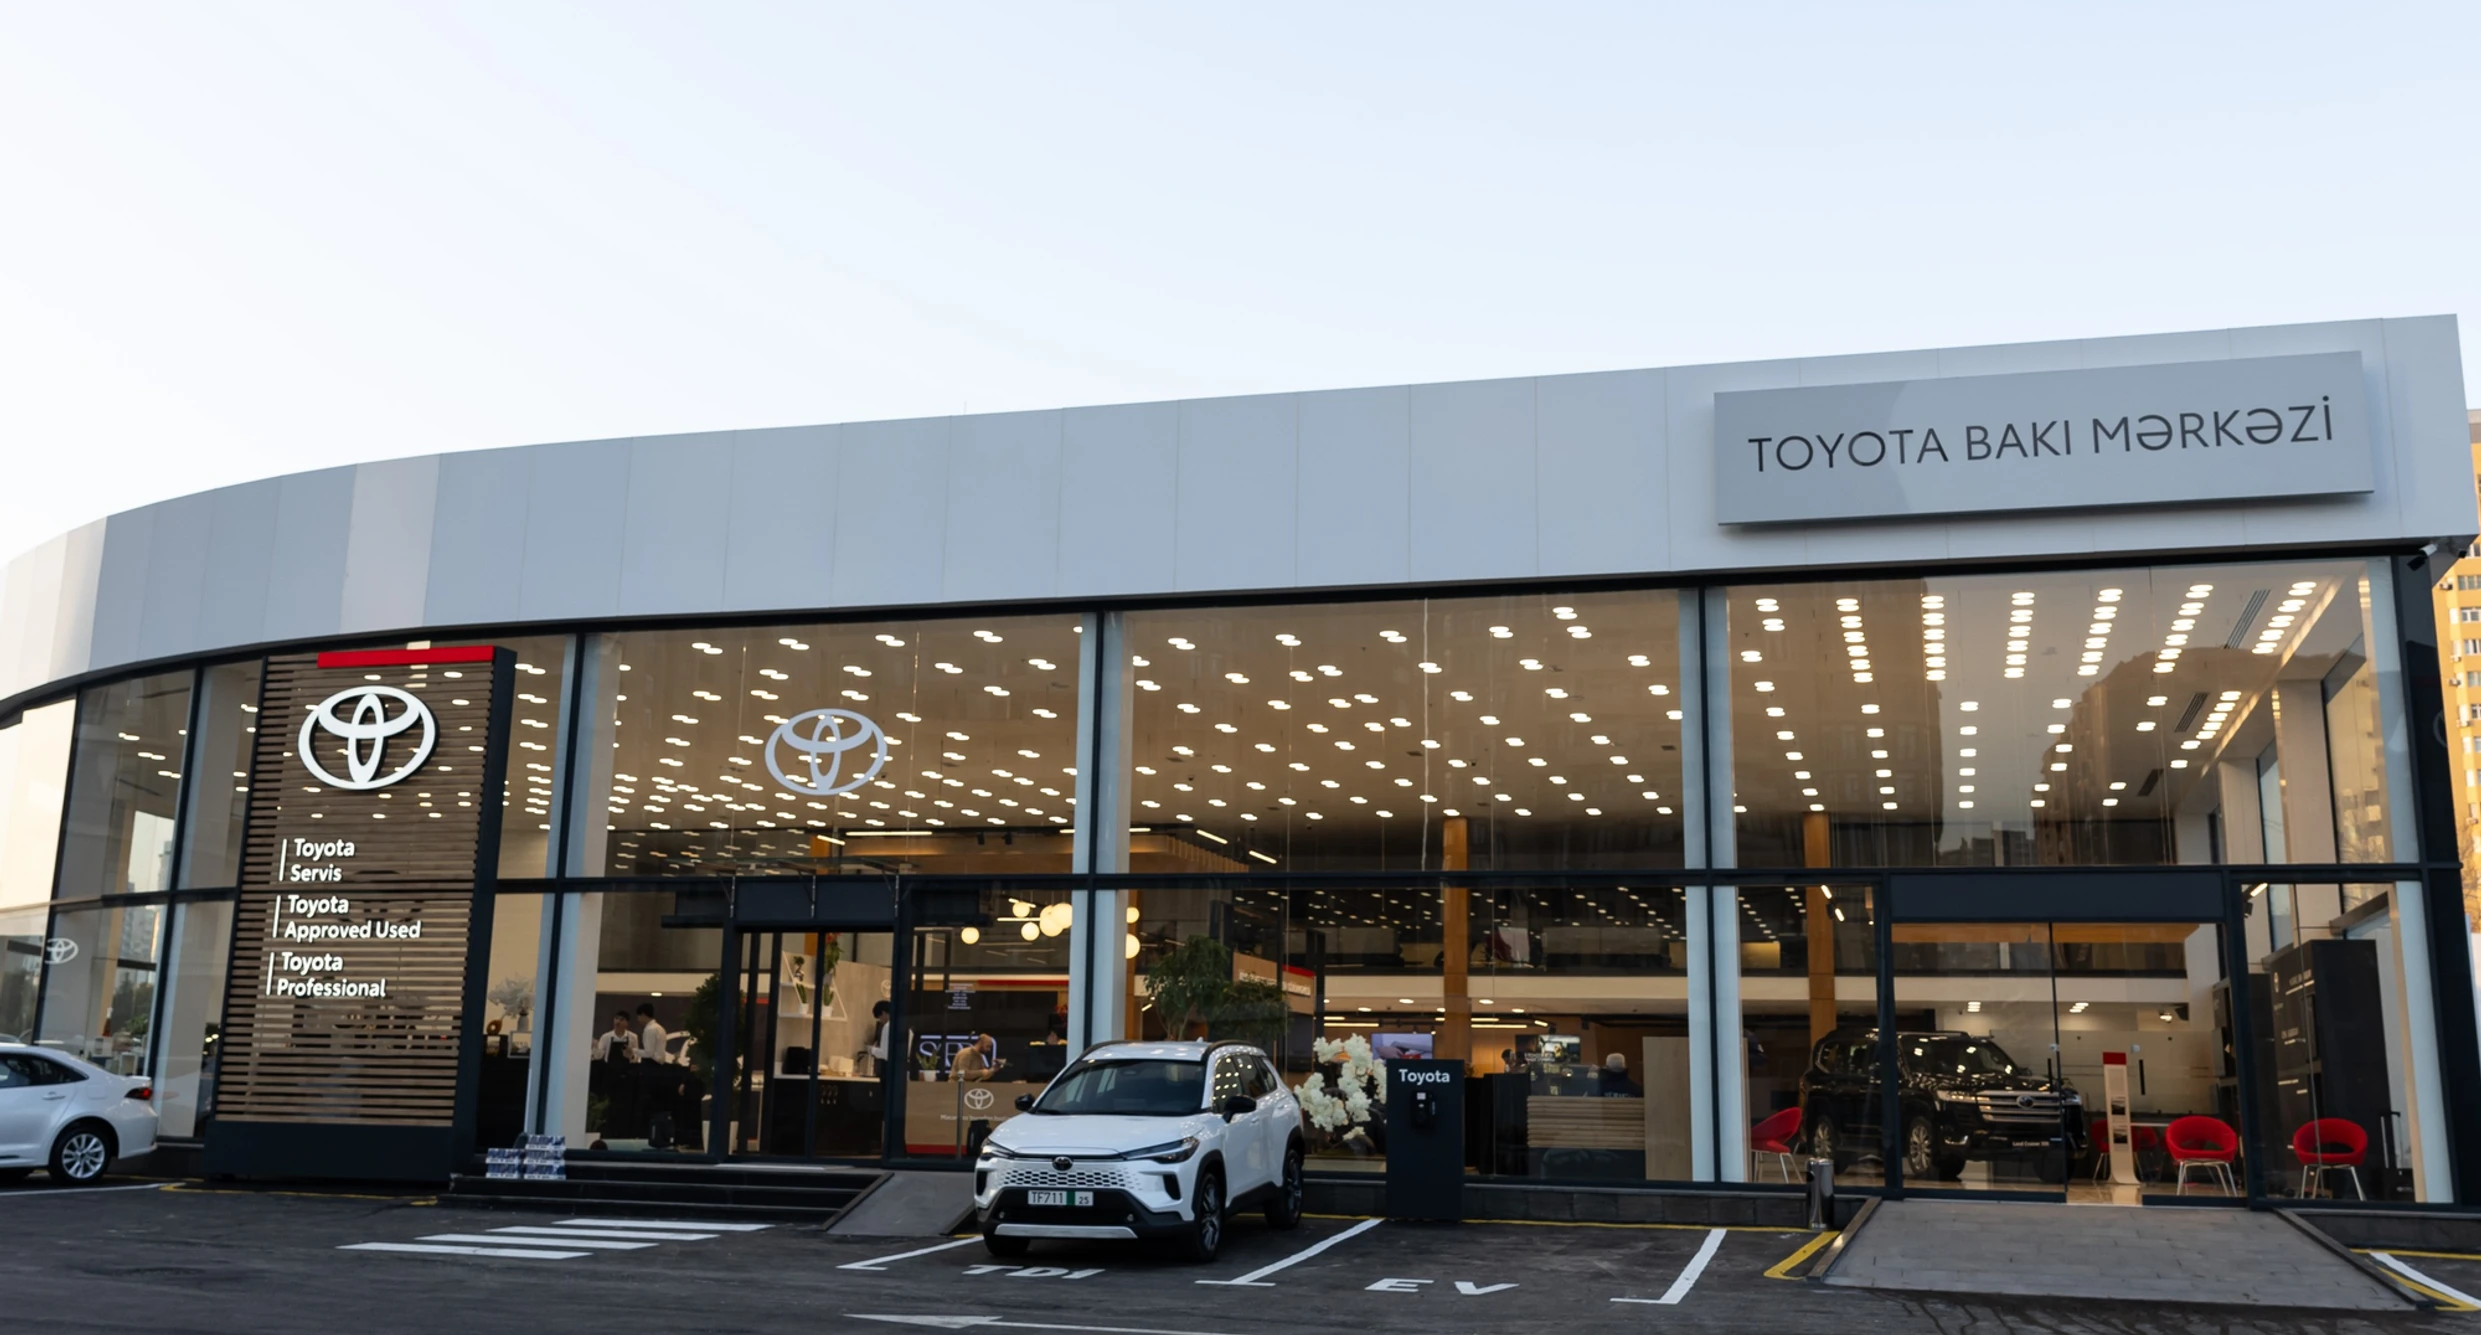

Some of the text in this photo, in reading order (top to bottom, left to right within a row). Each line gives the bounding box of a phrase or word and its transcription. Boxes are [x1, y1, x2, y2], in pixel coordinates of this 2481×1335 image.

[1747, 395, 2334, 474] TOYOTA BAKI MƏRKƏZİ
[293, 838, 356, 861] Toyota
[290, 863, 343, 882] Servis
[287, 894, 350, 918] Toyota
[284, 920, 422, 943] Approved Used
[281, 951, 343, 976] Toyota
[276, 977, 386, 998] Professional
[1398, 1068, 1451, 1086] Toyota
[1031, 1191, 1064, 1204] TF711
[962, 1264, 1106, 1280] TDI
[1364, 1277, 1520, 1295] EV
